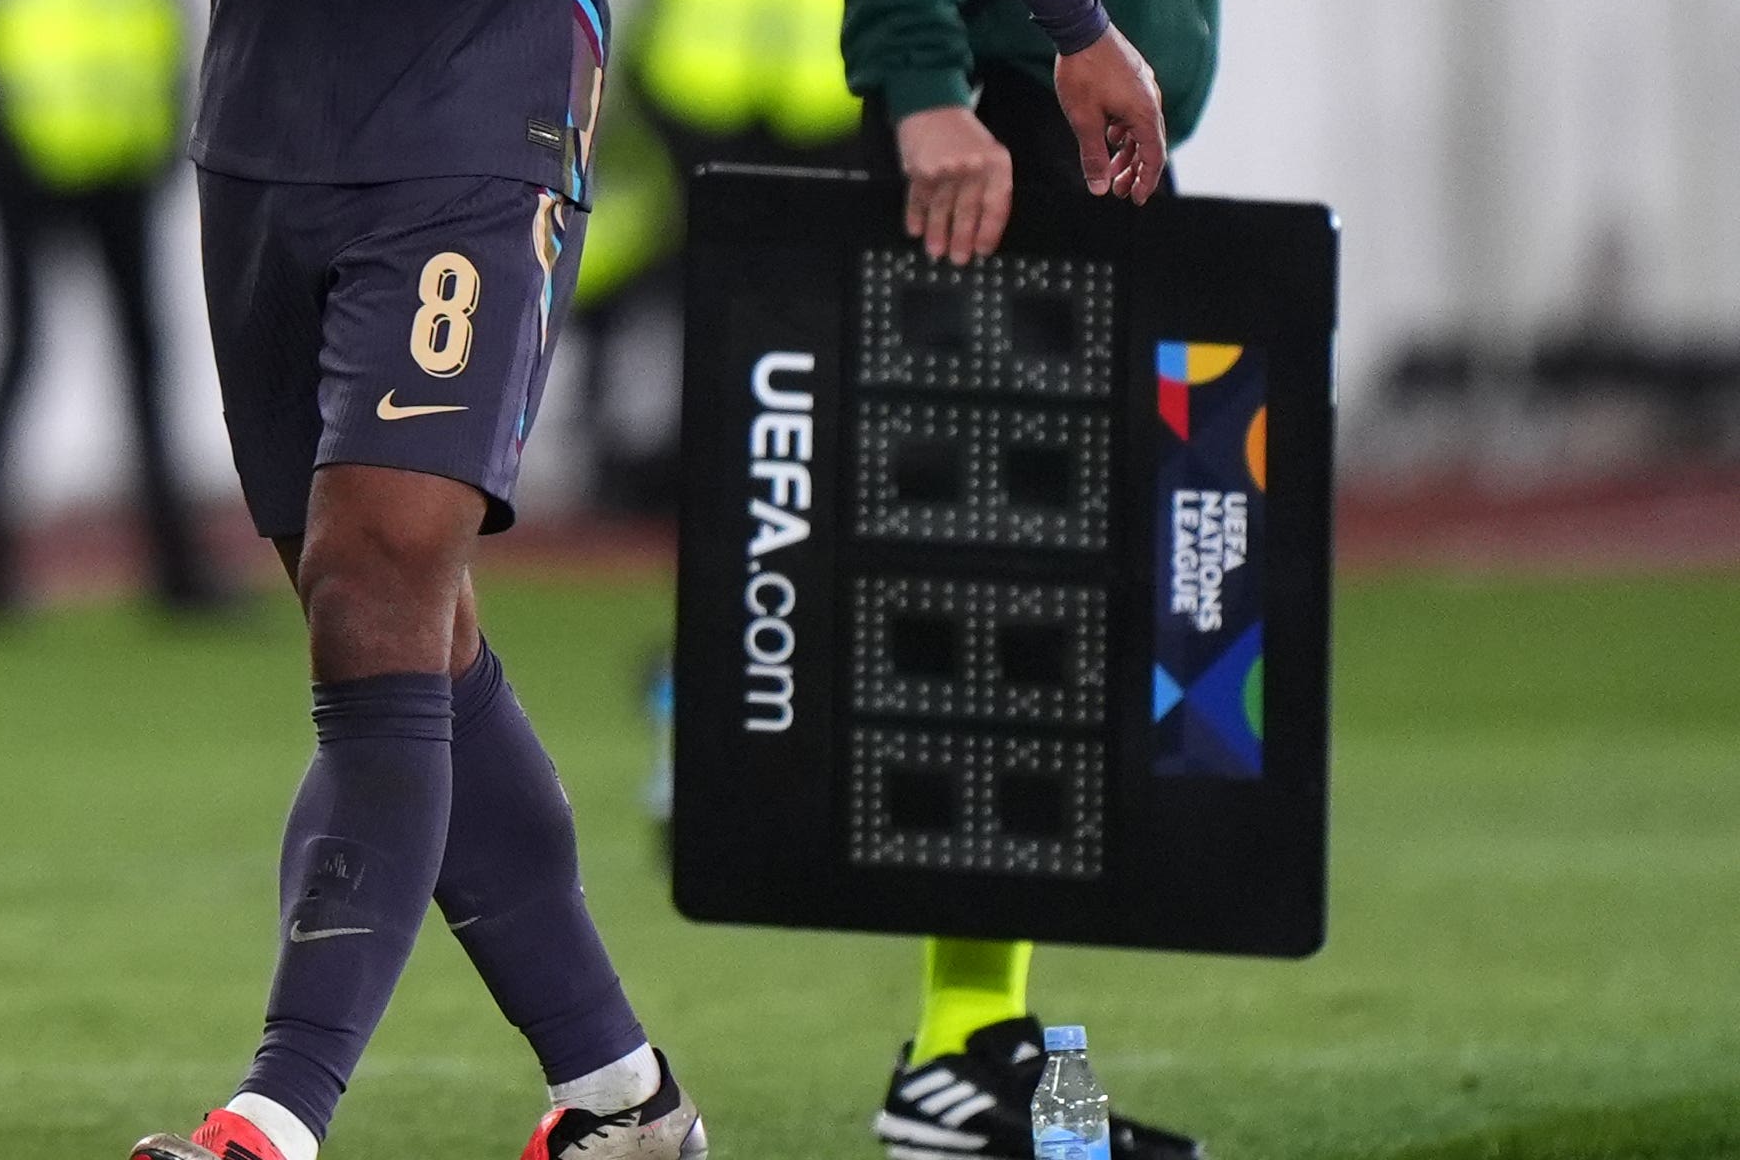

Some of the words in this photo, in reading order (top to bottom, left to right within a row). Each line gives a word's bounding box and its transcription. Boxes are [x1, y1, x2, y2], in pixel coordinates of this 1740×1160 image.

[410, 251, 481, 378] 8
[744, 351, 815, 732] UEFA.com
[1171, 490, 1200, 615] LEAGUE
[1197, 490, 1224, 633] NATIONS
[1223, 492, 1248, 573] UEFA
